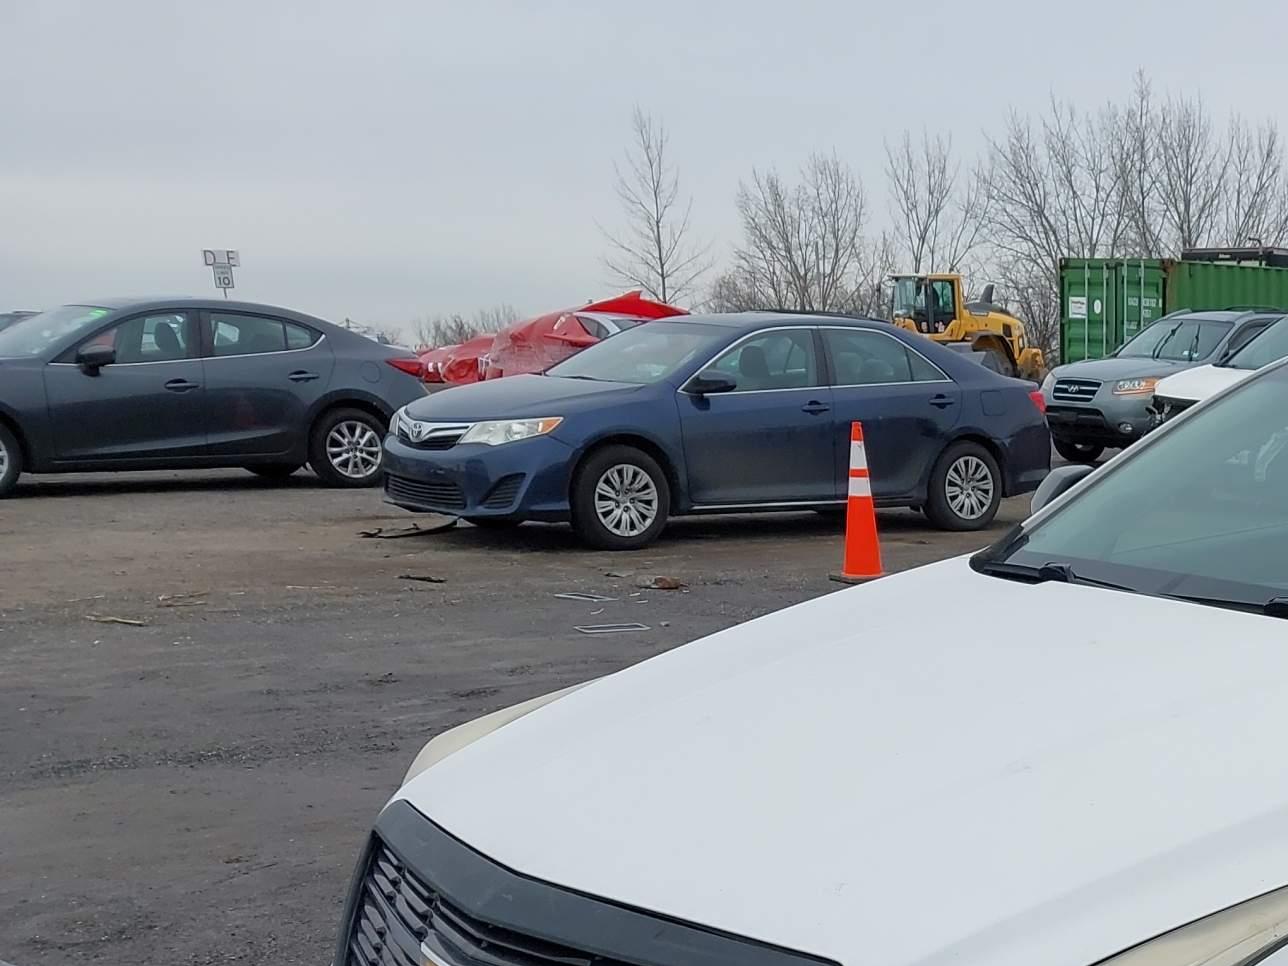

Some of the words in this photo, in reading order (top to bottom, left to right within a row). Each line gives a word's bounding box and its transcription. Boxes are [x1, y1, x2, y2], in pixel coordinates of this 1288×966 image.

[203, 250, 216, 266] D
[226, 250, 237, 267] E
[218, 277, 231, 286] 10
